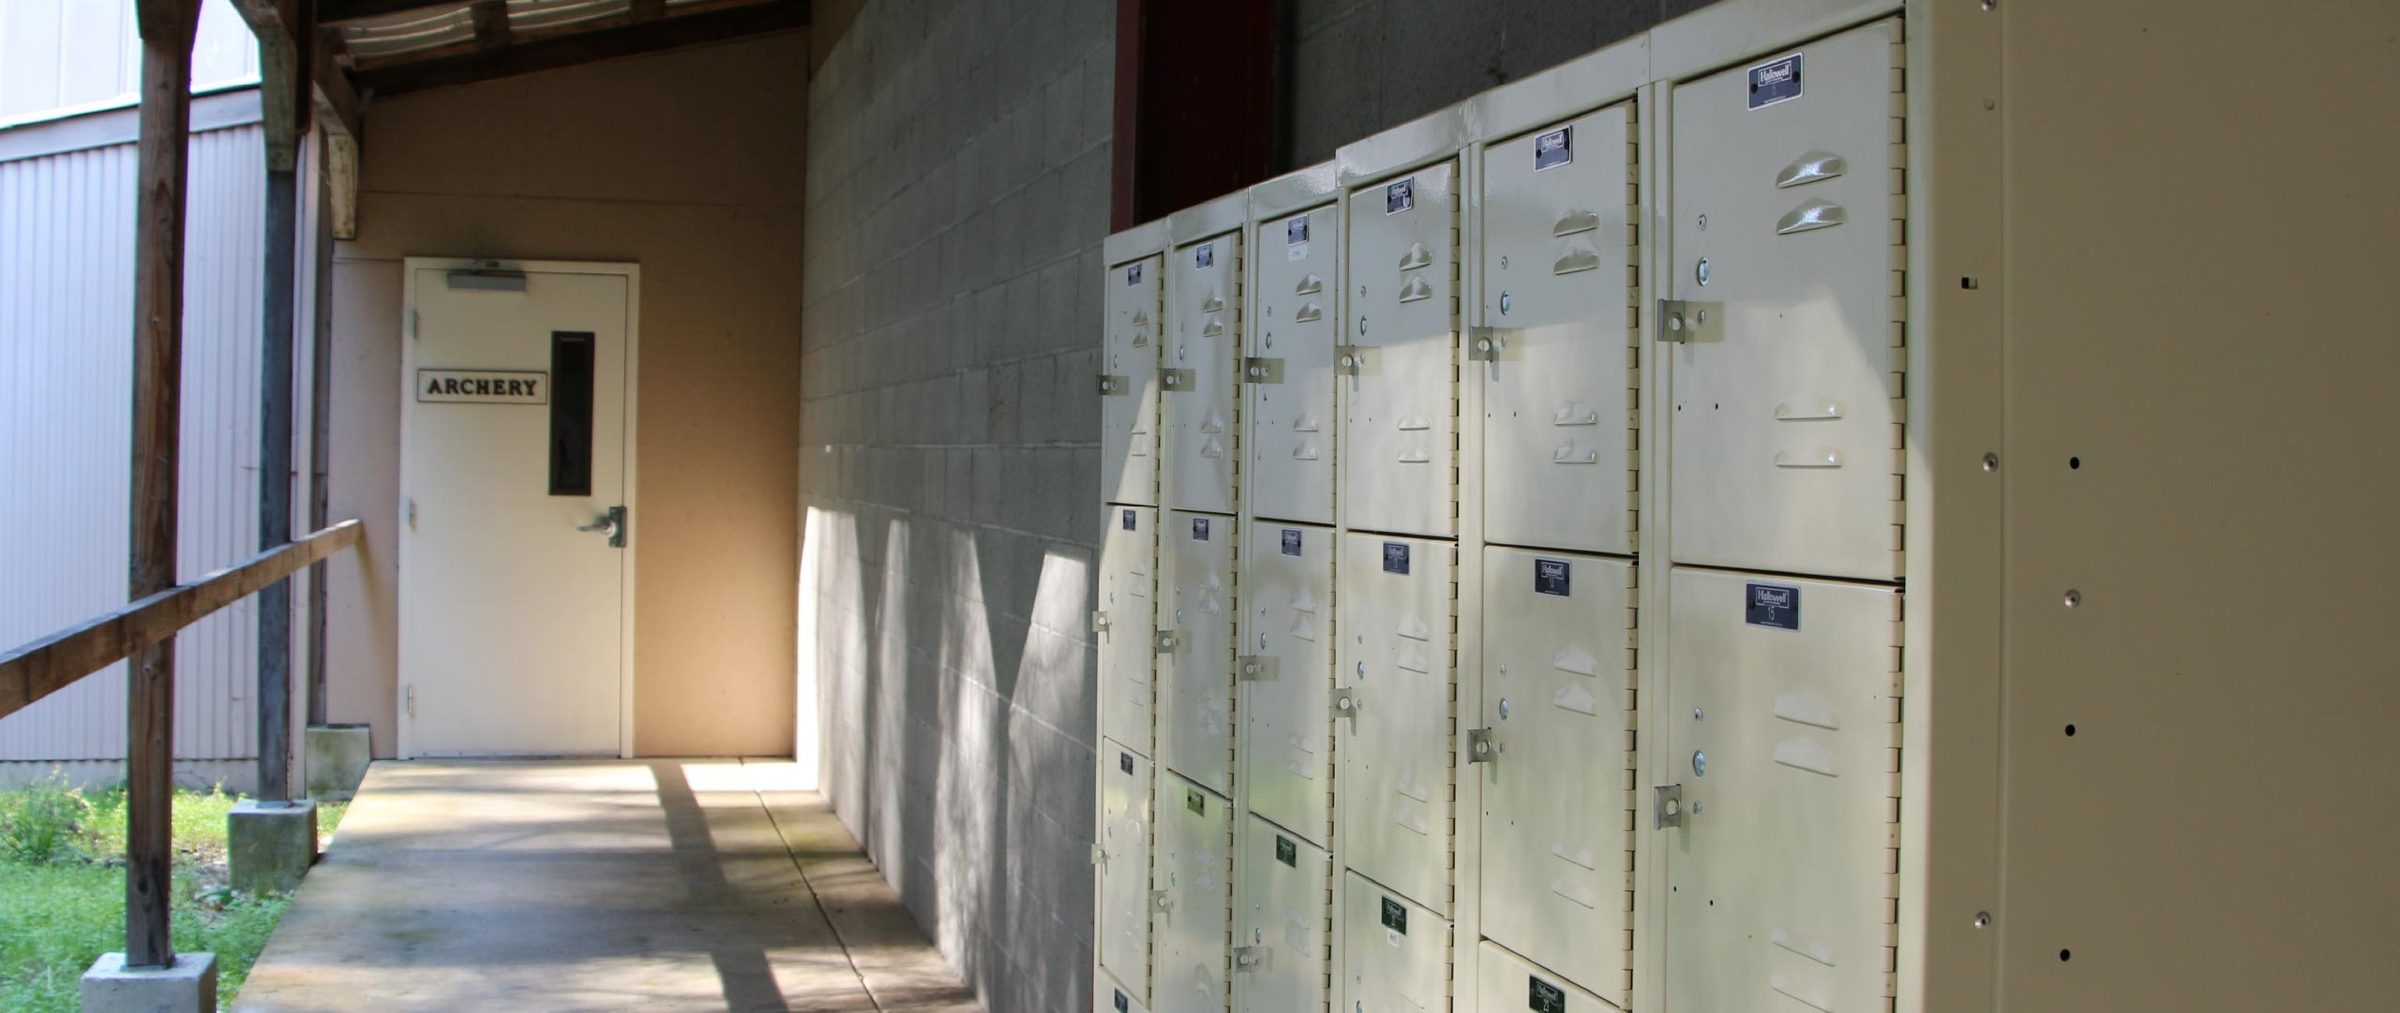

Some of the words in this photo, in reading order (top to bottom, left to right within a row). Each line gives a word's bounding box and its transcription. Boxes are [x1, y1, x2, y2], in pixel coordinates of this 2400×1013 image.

[1760, 64, 1790, 82] Hallowell
[427, 378, 537, 396] ARCHERY
[1757, 589, 1787, 603] Hallowell
[1768, 605, 1775, 621] 15
